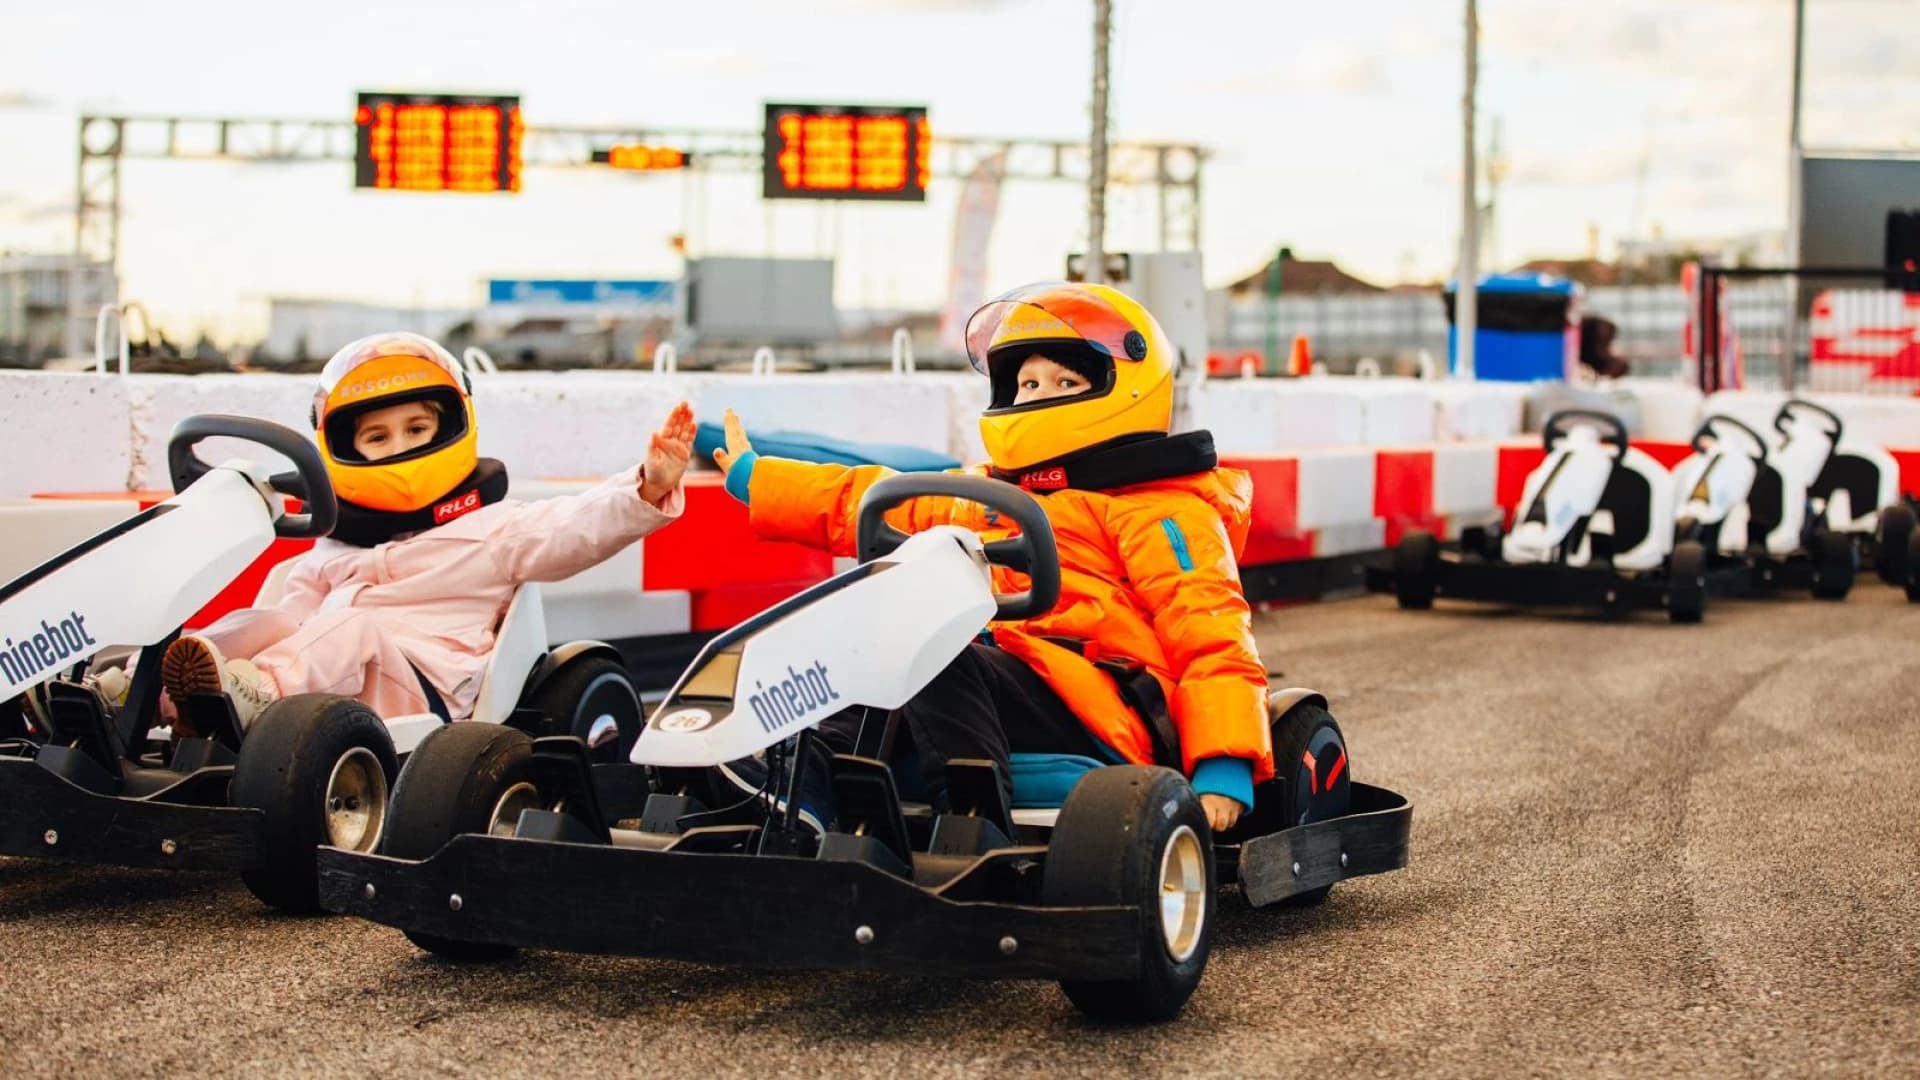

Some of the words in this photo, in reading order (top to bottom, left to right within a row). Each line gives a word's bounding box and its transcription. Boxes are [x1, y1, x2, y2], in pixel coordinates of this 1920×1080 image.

[1025, 470, 1062, 482] RLG
[439, 494, 476, 517] RLG
[0, 611, 96, 686] ninebot
[750, 660, 840, 733] ninebot
